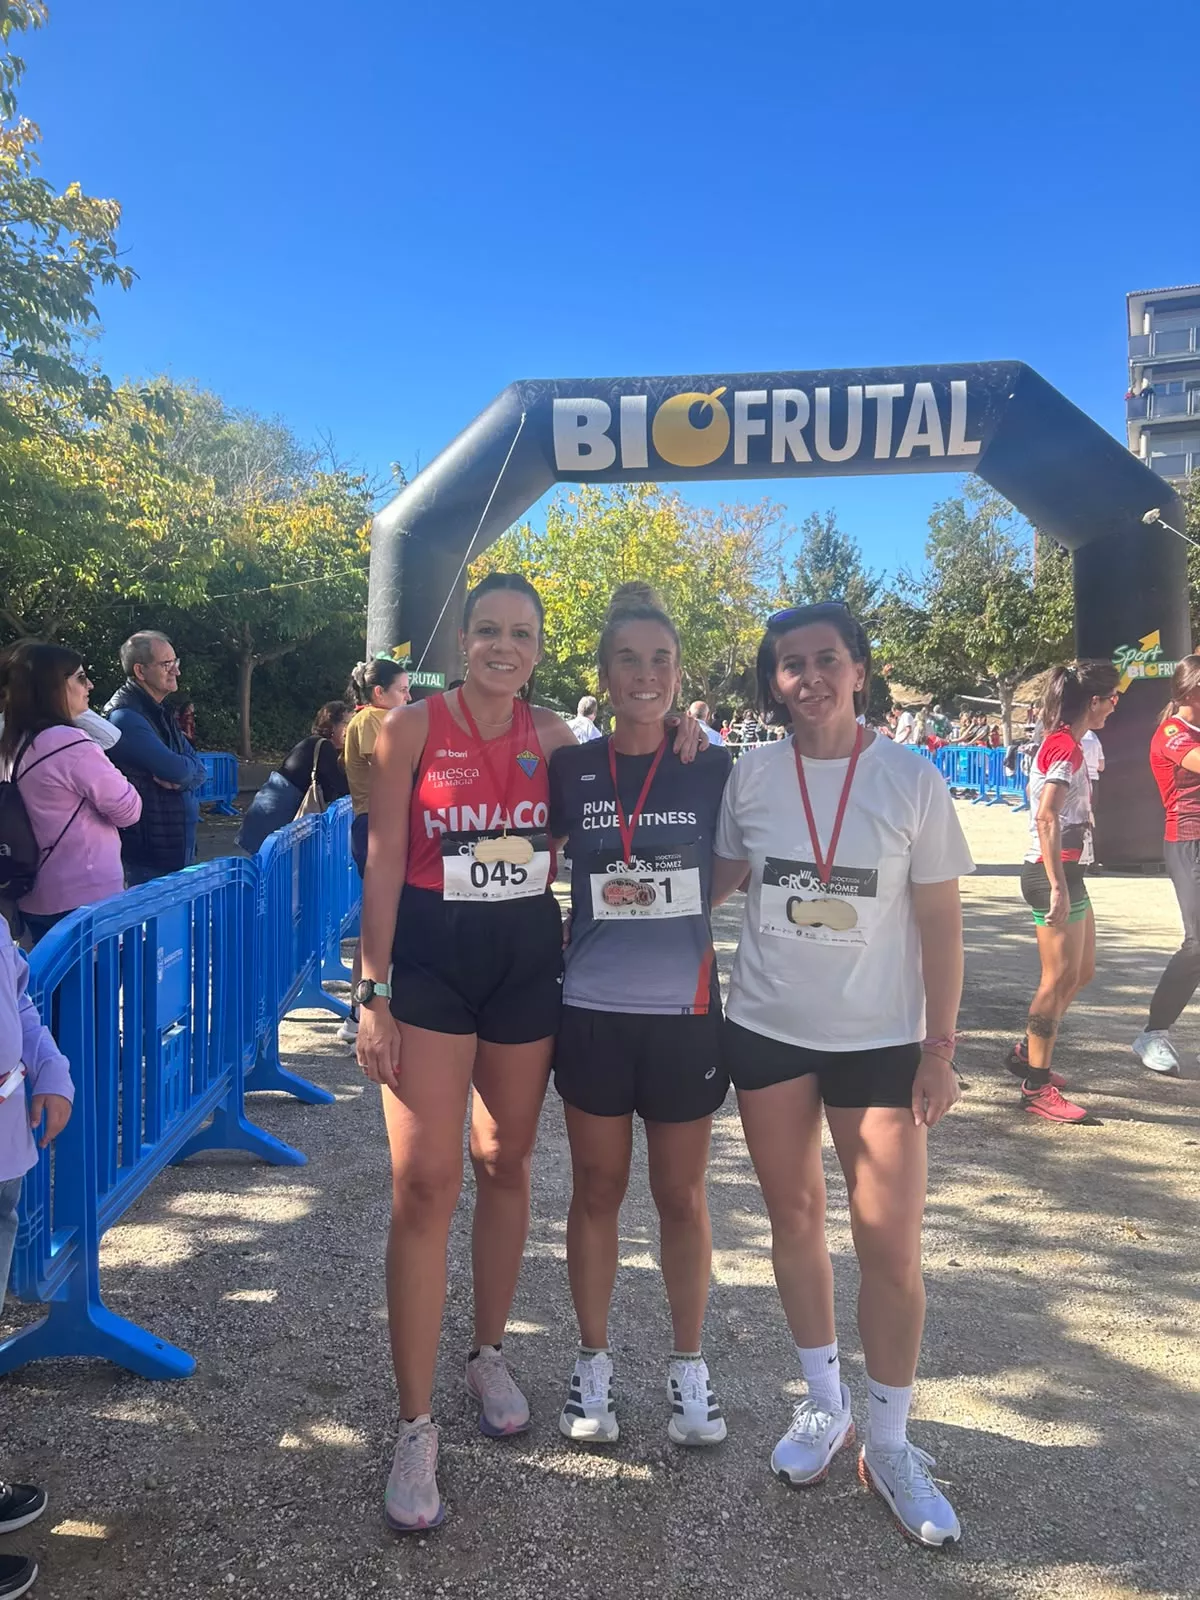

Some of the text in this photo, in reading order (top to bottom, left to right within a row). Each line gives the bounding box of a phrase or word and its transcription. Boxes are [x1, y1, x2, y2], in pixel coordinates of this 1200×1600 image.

[1111, 644, 1163, 669] Sport
[1127, 663, 1177, 678] BIOFRU
[408, 673, 441, 686] FRUTAL
[583, 800, 616, 815] RUN
[423, 800, 549, 838] HINACO
[655, 860, 682, 869] PÓMEZ
[470, 860, 528, 888] 045
[779, 874, 828, 891] CROSS
[829, 882, 859, 892] PÓMEZ
